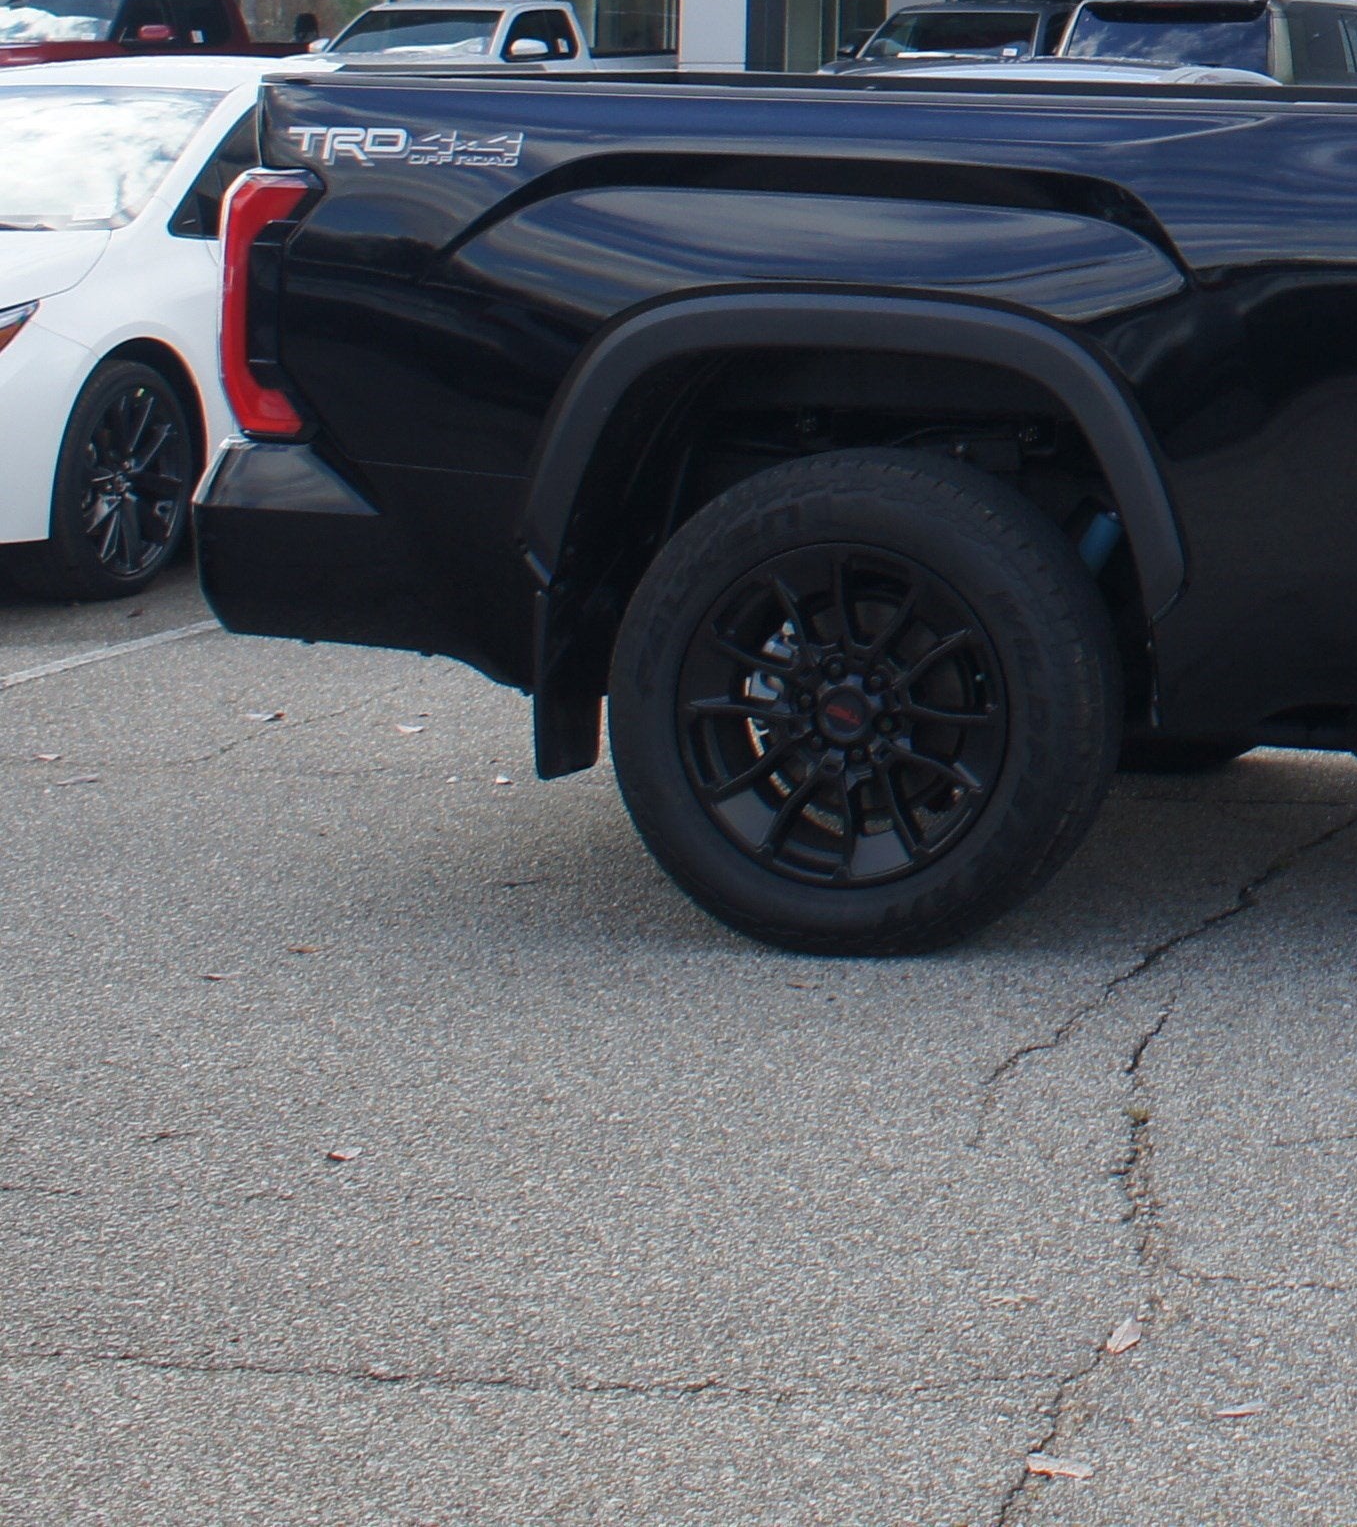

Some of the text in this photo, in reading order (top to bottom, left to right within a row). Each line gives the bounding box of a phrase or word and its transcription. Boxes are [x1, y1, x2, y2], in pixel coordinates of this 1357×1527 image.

[287, 126, 412, 166] TRD
[408, 154, 520, 167] OFF ROAD
